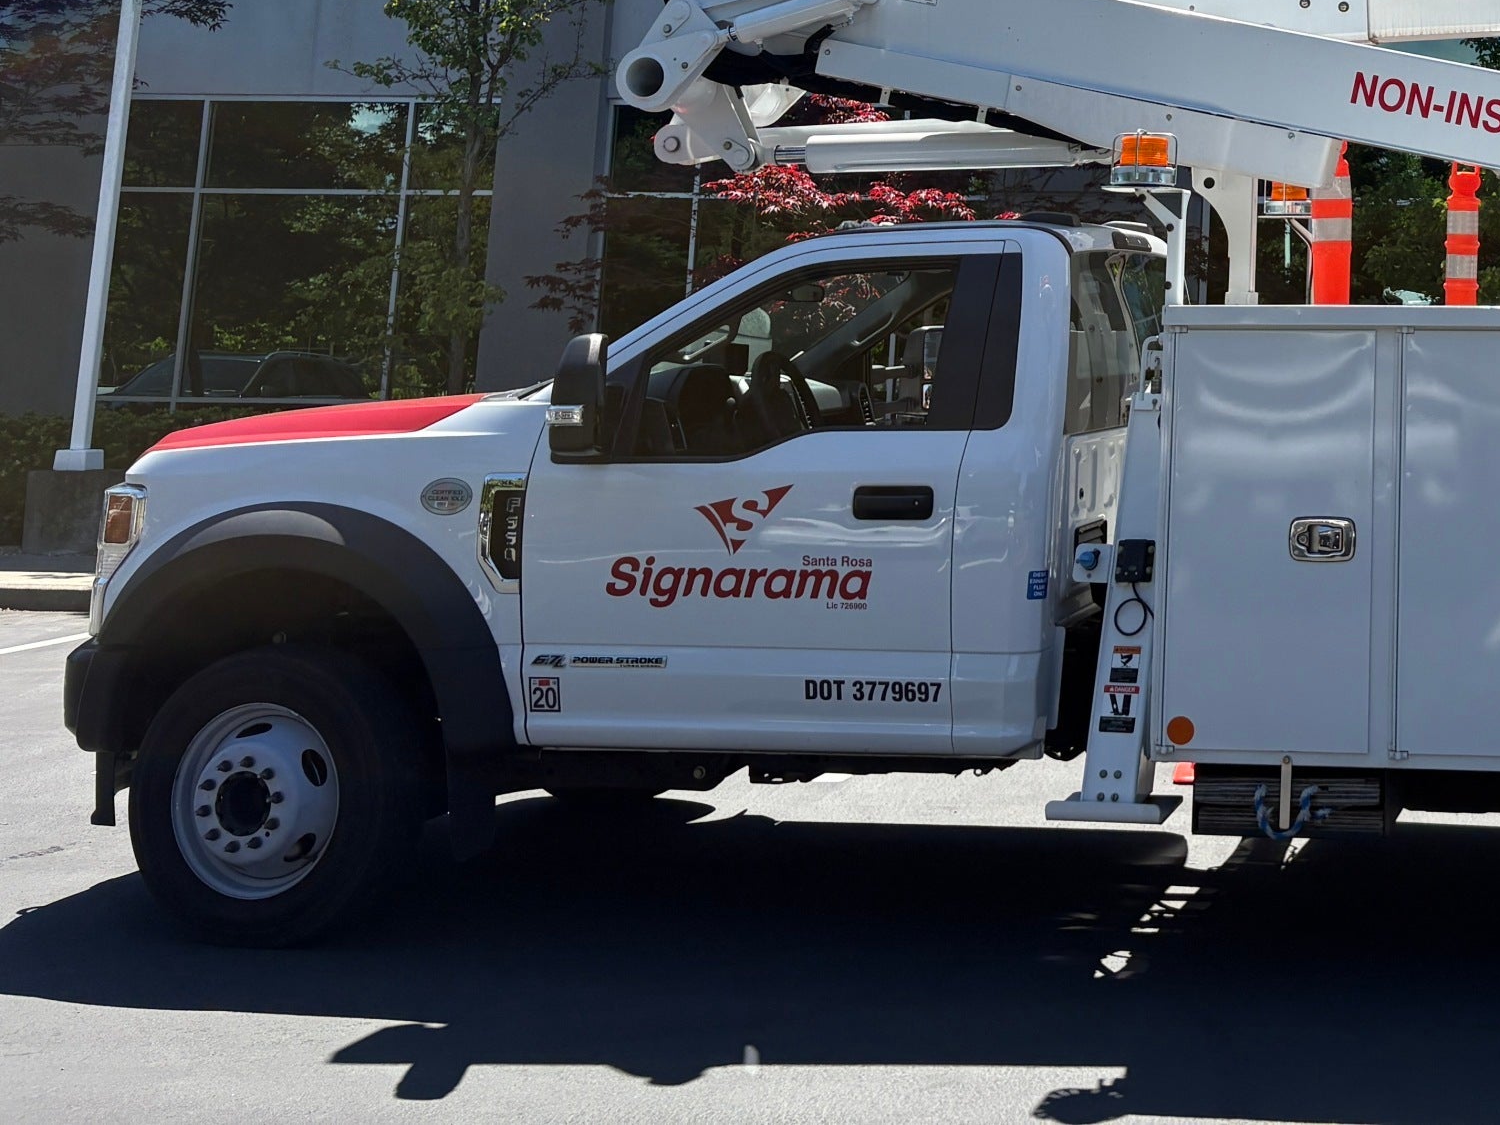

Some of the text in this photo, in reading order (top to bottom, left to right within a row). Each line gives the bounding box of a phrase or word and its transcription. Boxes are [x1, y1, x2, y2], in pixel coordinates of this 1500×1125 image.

[802, 555, 873, 568] Santa Rosa
[606, 555, 872, 608] Signarama
[572, 656, 613, 664] POWER
[532, 687, 557, 709] 20
[805, 679, 942, 702] DOT 3779697
